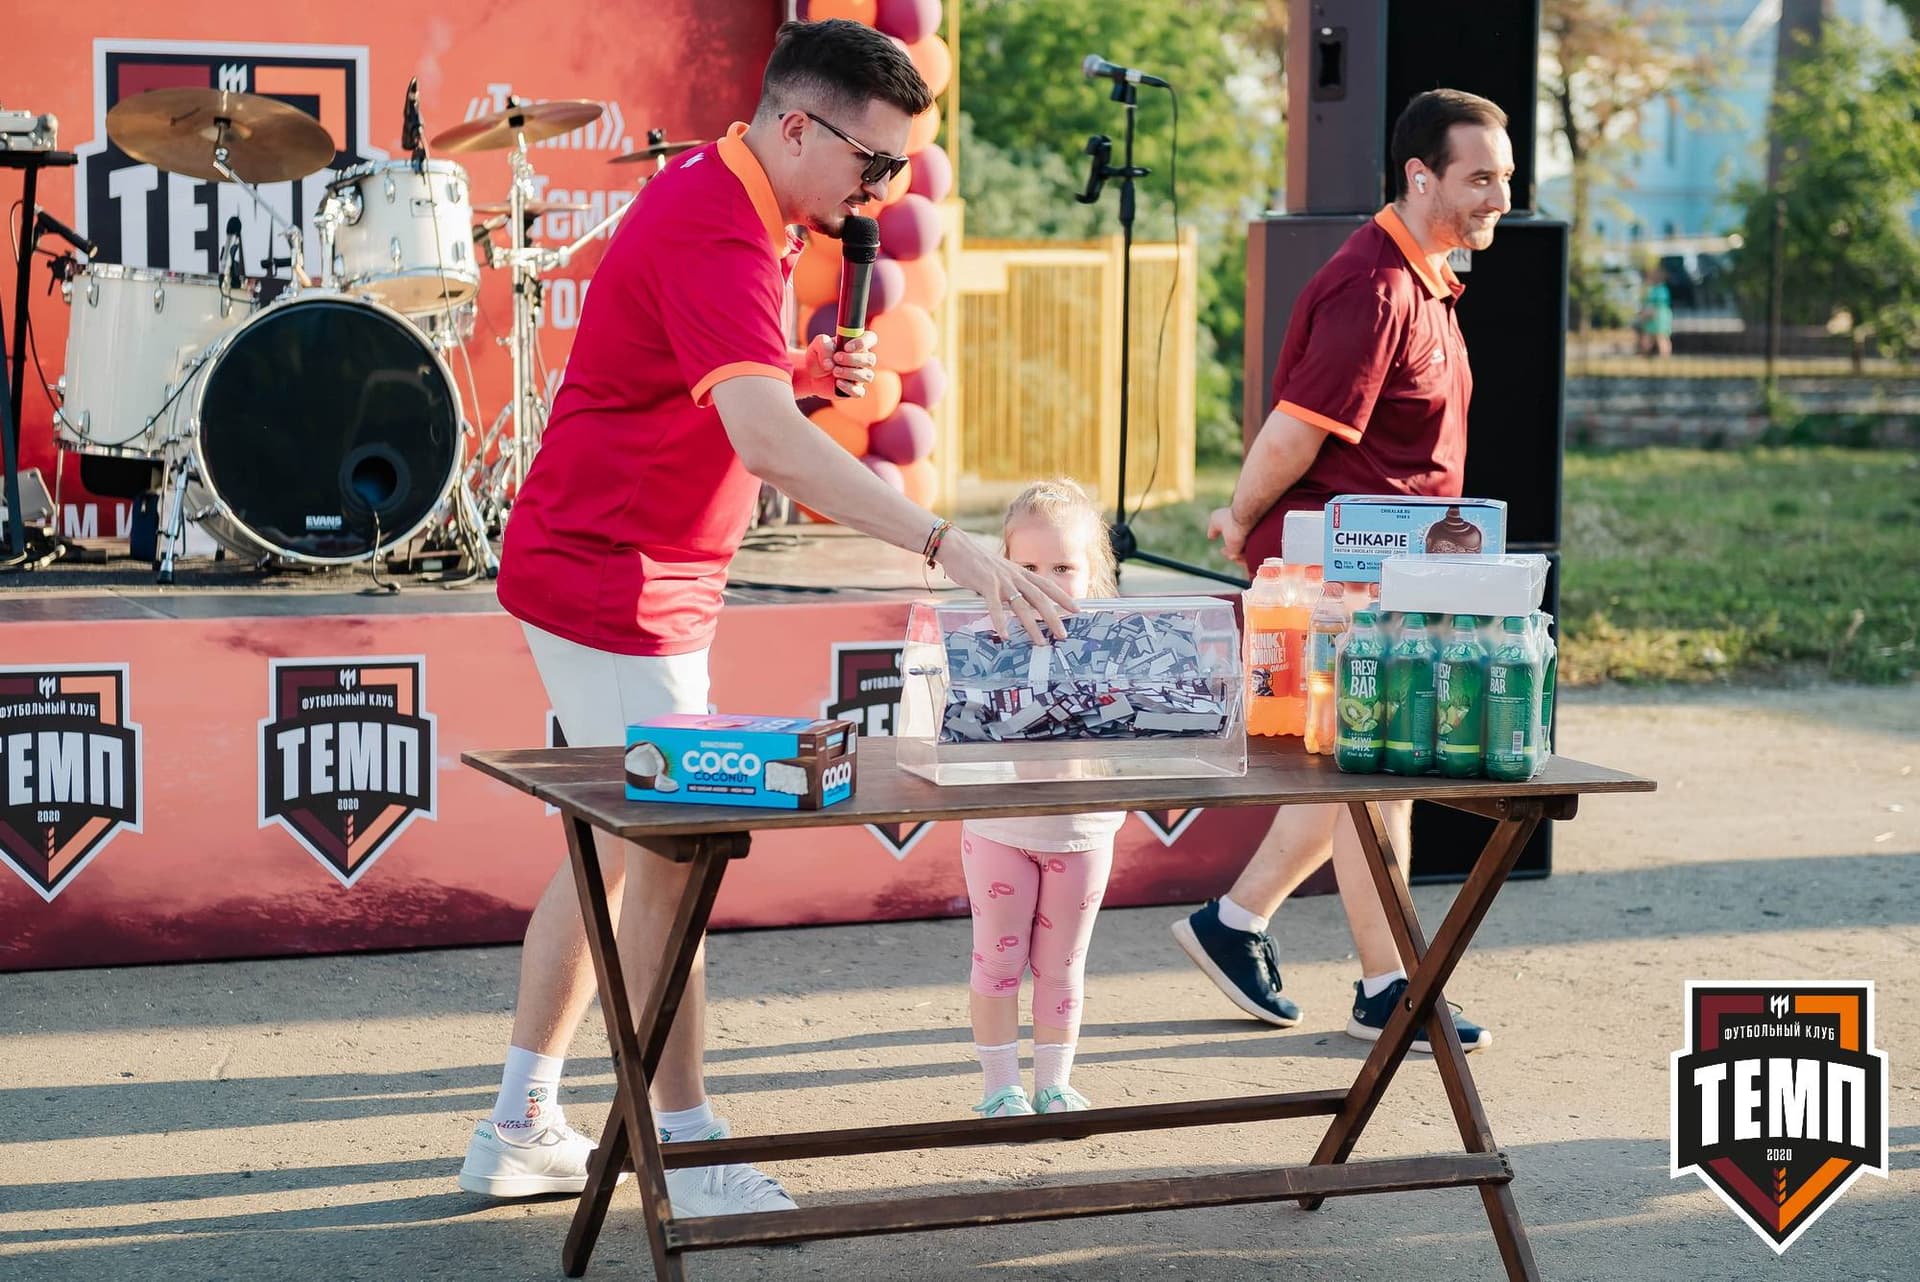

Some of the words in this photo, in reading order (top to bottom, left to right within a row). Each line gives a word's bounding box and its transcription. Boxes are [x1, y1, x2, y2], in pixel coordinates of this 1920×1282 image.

[306, 515, 341, 526] EVANS
[1335, 532, 1407, 548] CHIKAPIE
[1351, 660, 1378, 676] FRESH
[1490, 666, 1507, 679] FRESH
[1350, 676, 1377, 699] BAR
[1489, 679, 1506, 695] BAR
[302, 691, 365, 710] ФУТБОЛЬНЫЙ
[369, 694, 394, 708] КЛУБ
[70, 702, 96, 717] КЛУБ
[277, 721, 419, 801] ТЕМП
[682, 750, 762, 776] COCO
[0, 731, 124, 809] ЕМП
[694, 772, 749, 784] COCONUT
[822, 762, 851, 791] COCO
